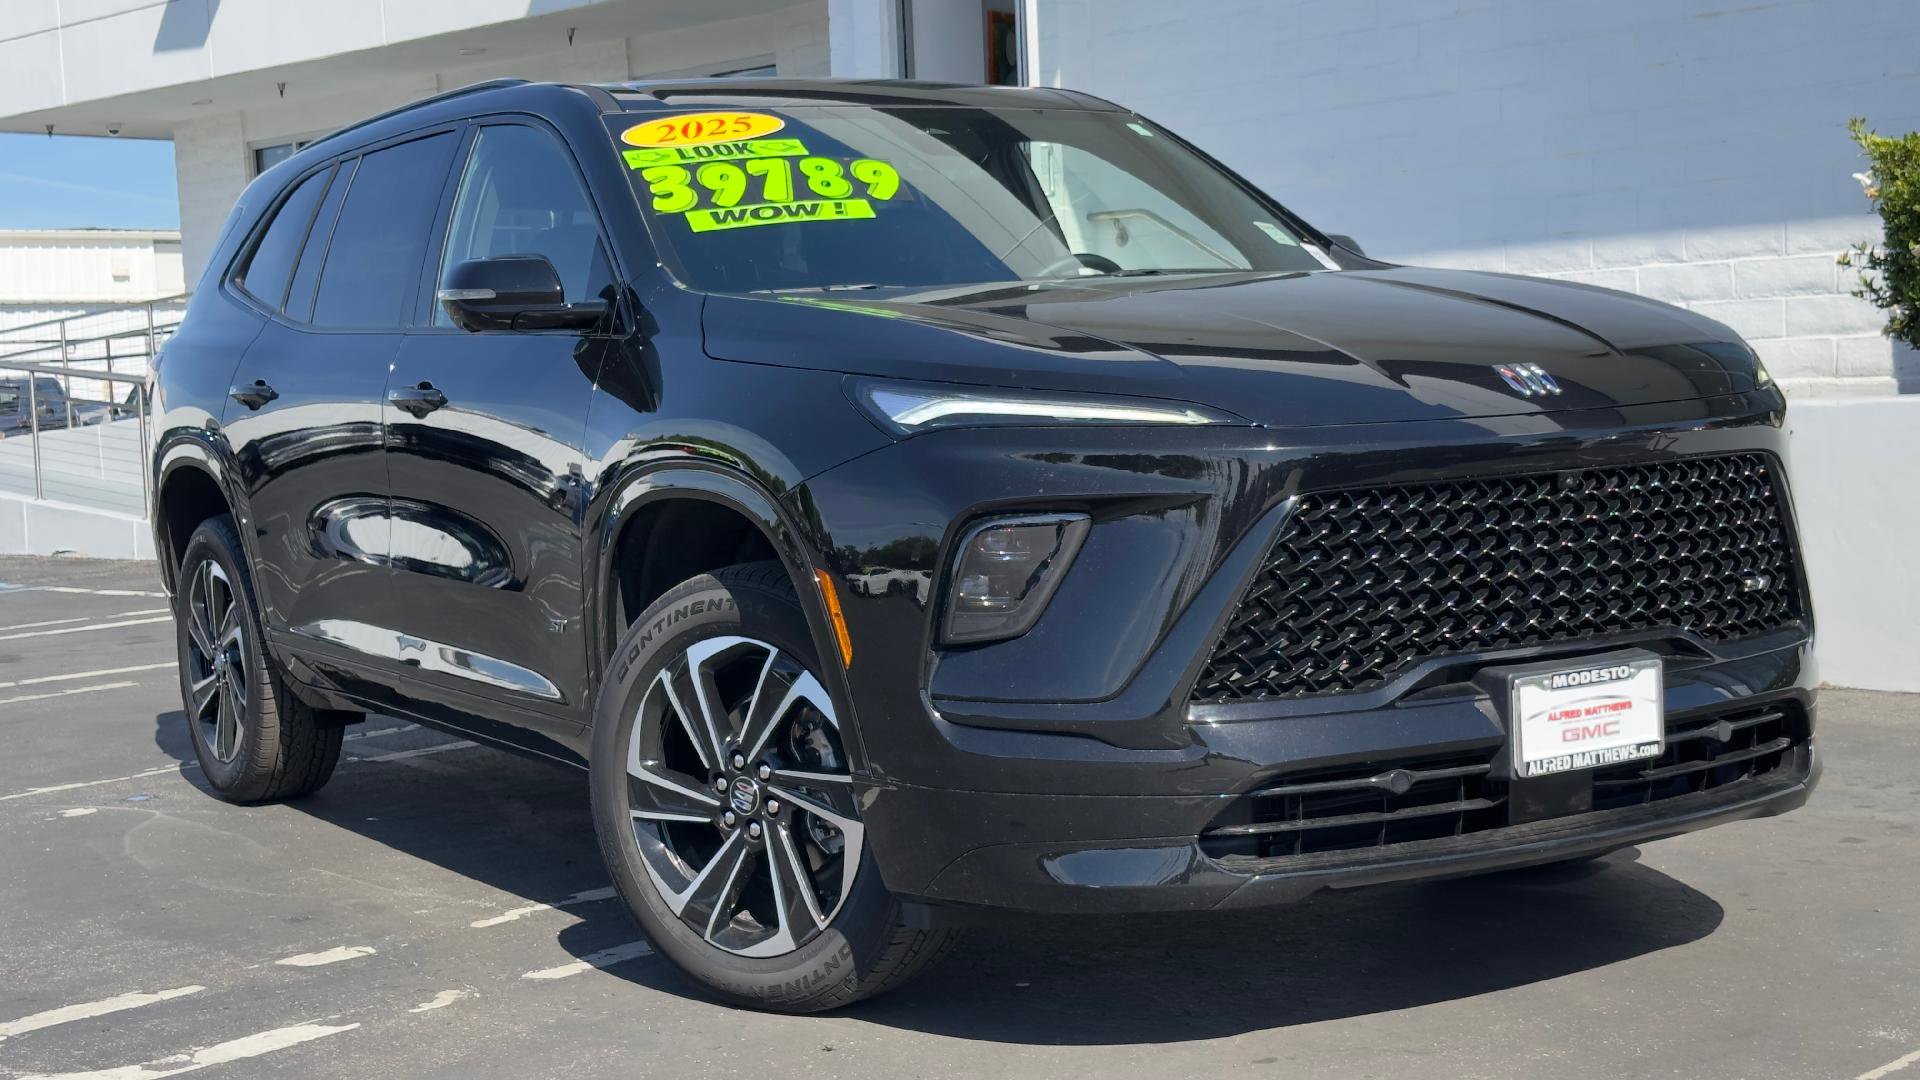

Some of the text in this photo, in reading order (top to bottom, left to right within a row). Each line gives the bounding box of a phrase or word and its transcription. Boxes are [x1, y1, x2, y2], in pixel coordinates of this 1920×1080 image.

[656, 116, 752, 143] 2025
[678, 141, 756, 160] LOOK
[641, 157, 900, 213] 39789
[617, 597, 752, 685] CONTINENT
[1552, 666, 1630, 689] MODESTO
[1547, 709, 1582, 722] ALFRED
[1584, 700, 1632, 717] MATTHEWS
[1562, 720, 1621, 742] GMC
